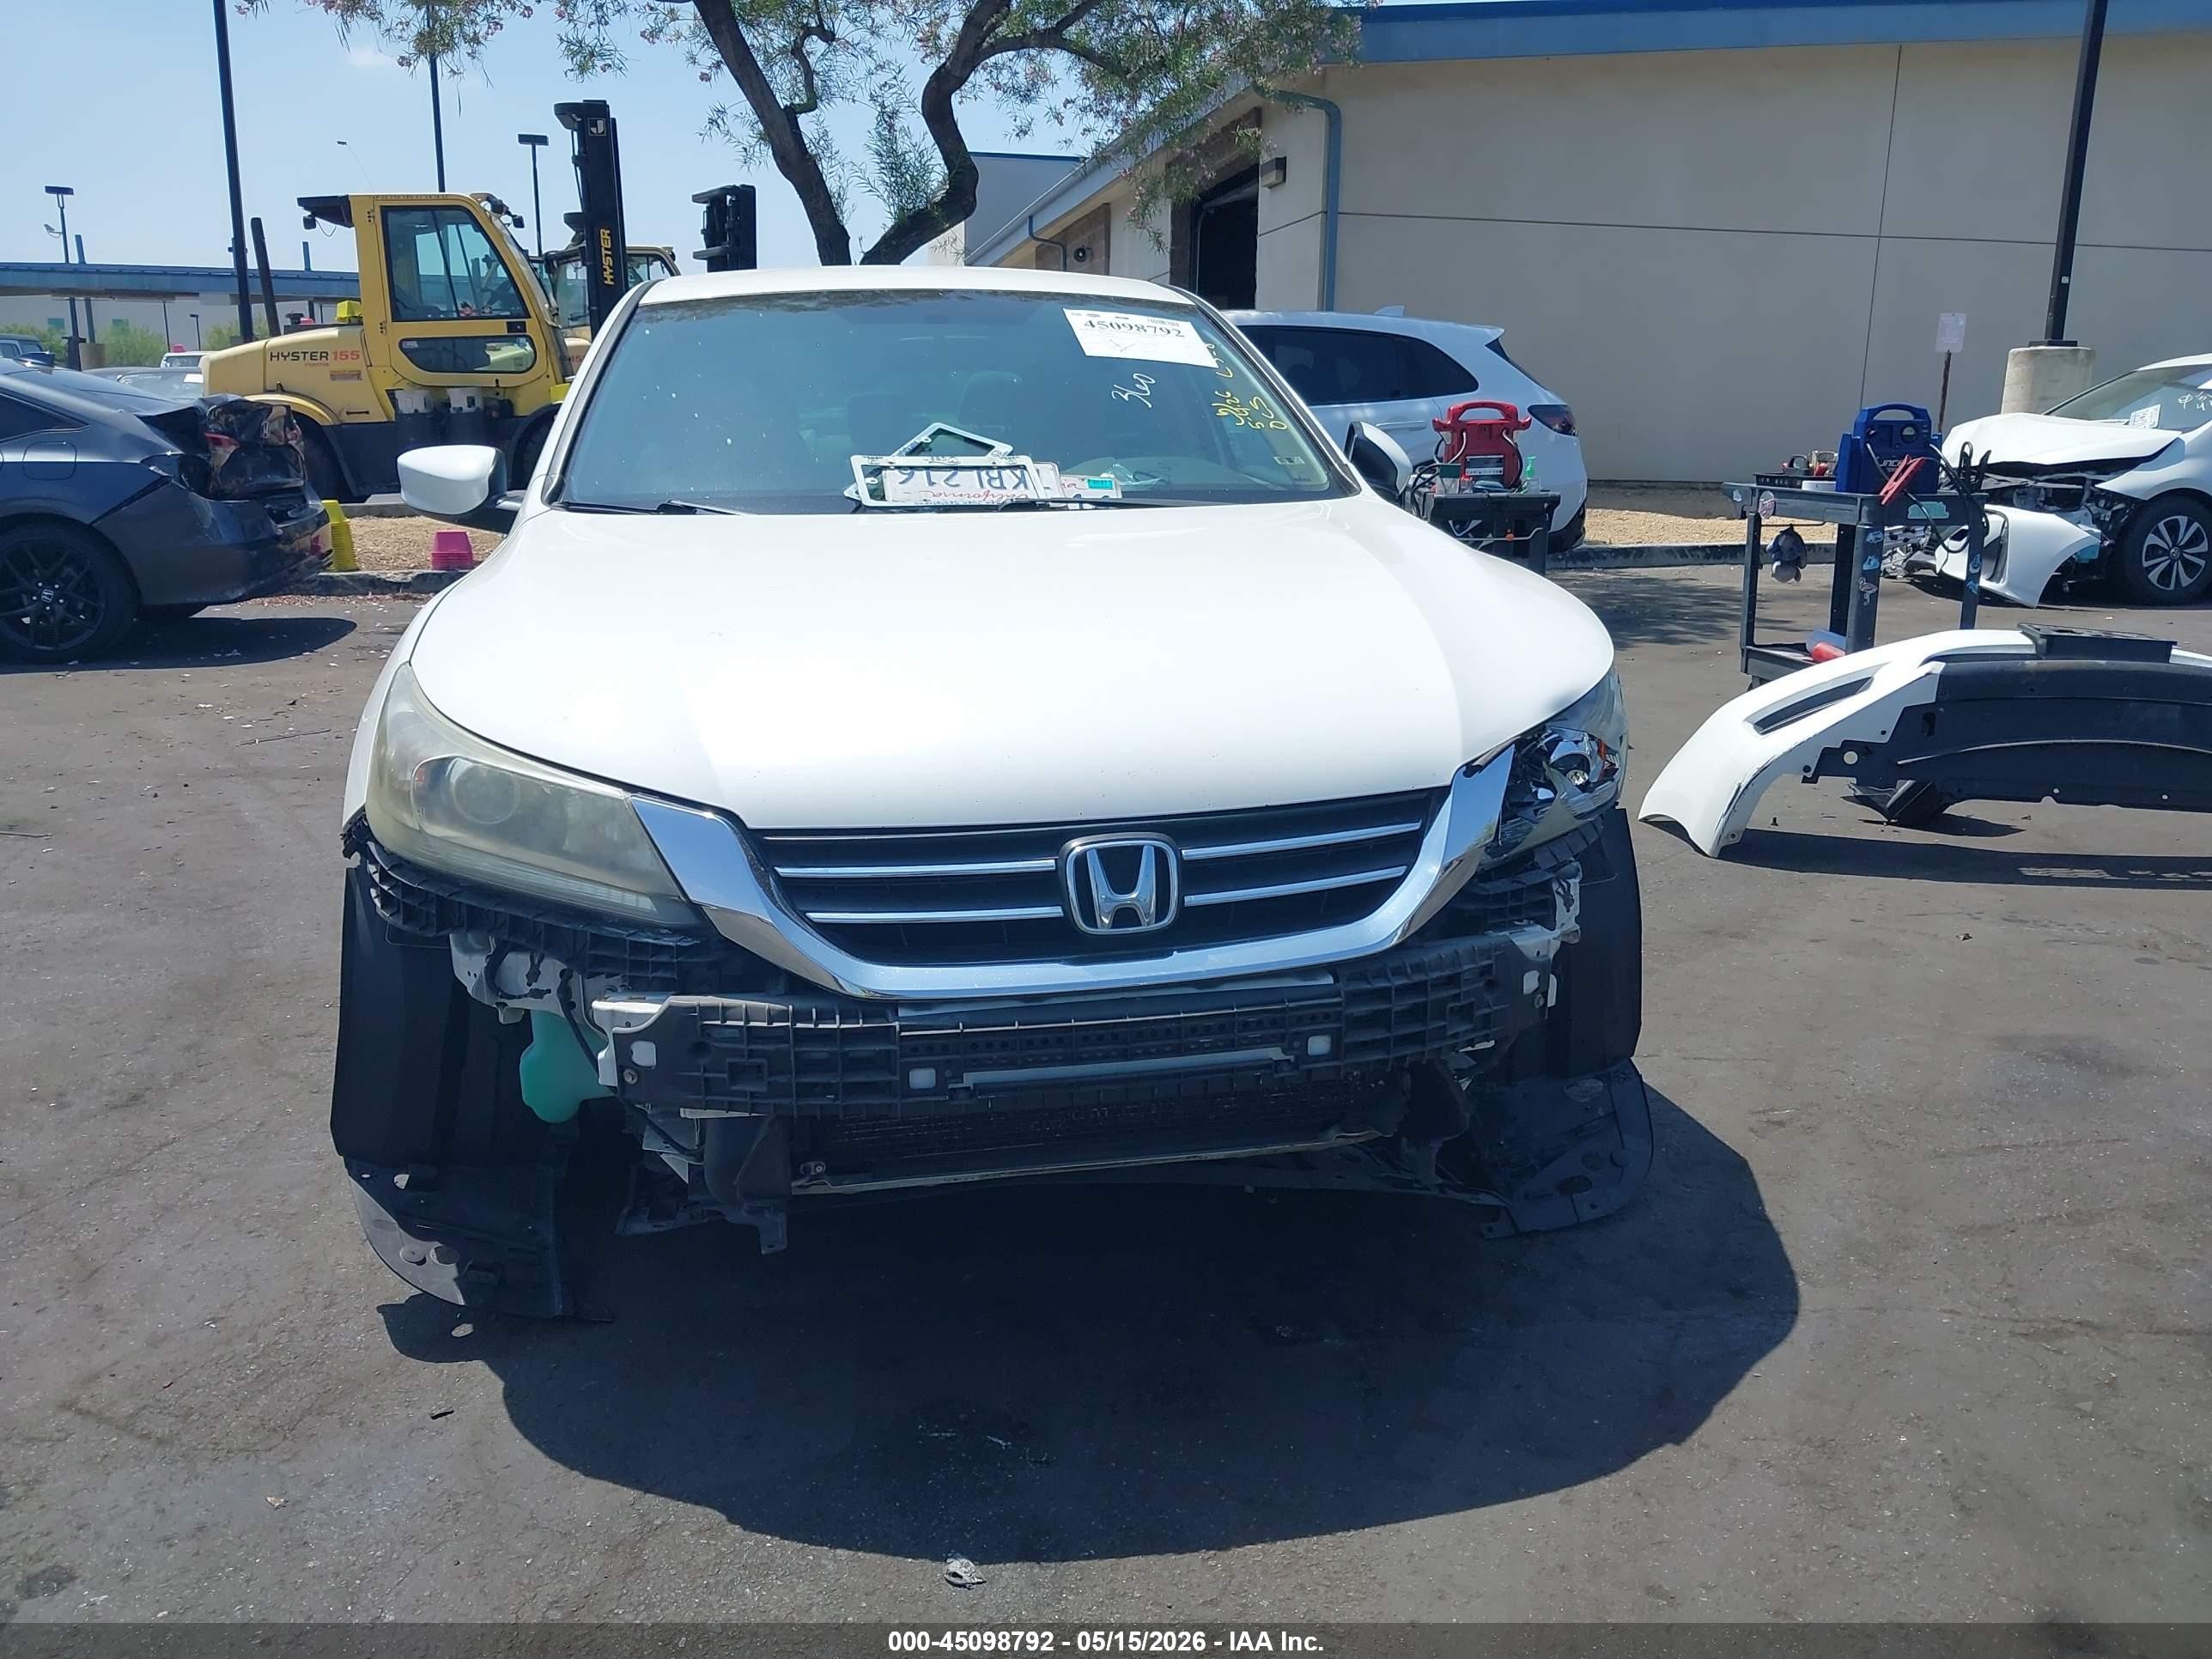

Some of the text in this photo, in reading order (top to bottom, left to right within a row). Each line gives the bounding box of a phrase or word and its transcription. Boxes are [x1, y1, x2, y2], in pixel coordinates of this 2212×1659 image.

[599, 228, 616, 286] HYSTER
[1084, 319, 1186, 337] 45098792
[270, 350, 361, 362] HYSTER 155
